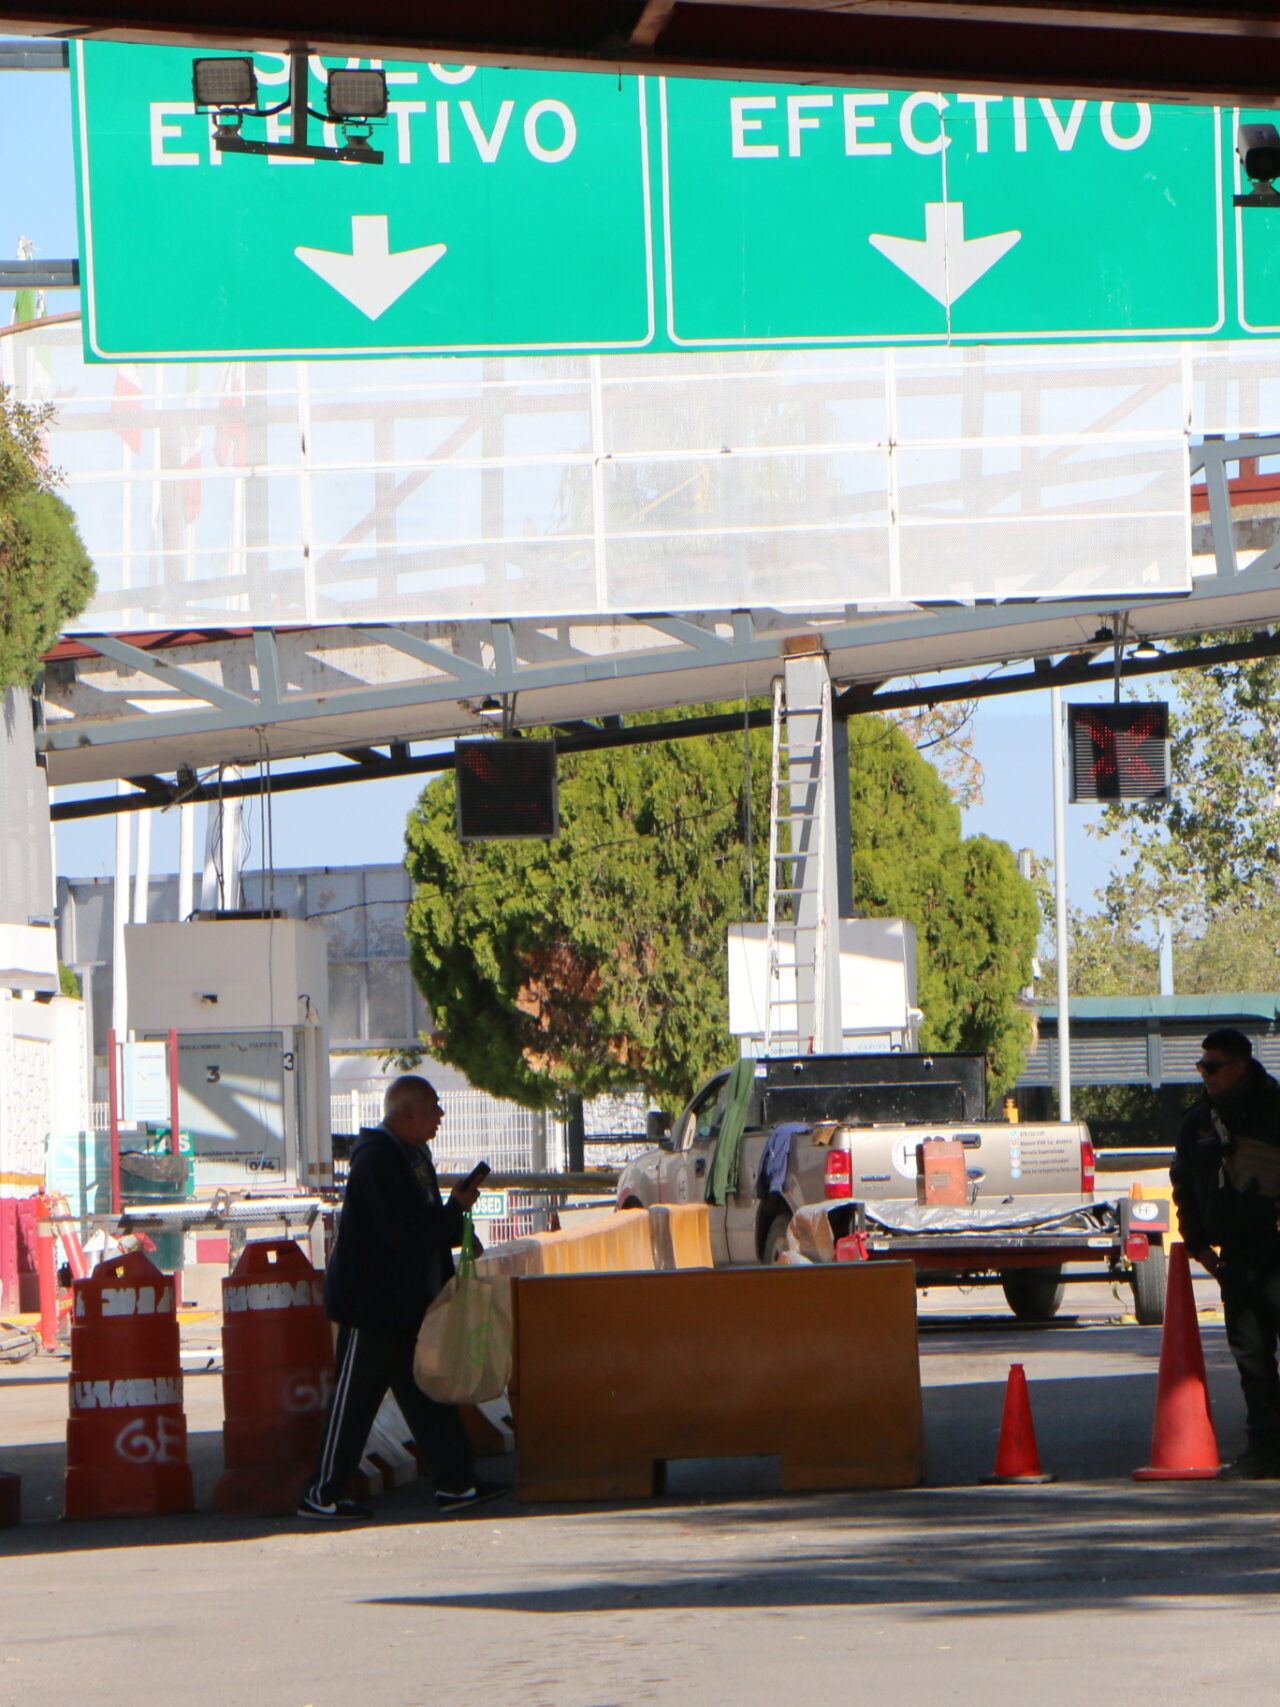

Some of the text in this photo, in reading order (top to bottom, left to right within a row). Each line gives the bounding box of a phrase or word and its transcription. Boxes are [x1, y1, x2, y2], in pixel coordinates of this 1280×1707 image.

[729, 90, 1153, 159] EFECTIVO
[282, 1052, 295, 1072] 3
[205, 1065, 221, 1084] 3
[472, 1196, 502, 1215] OSED
